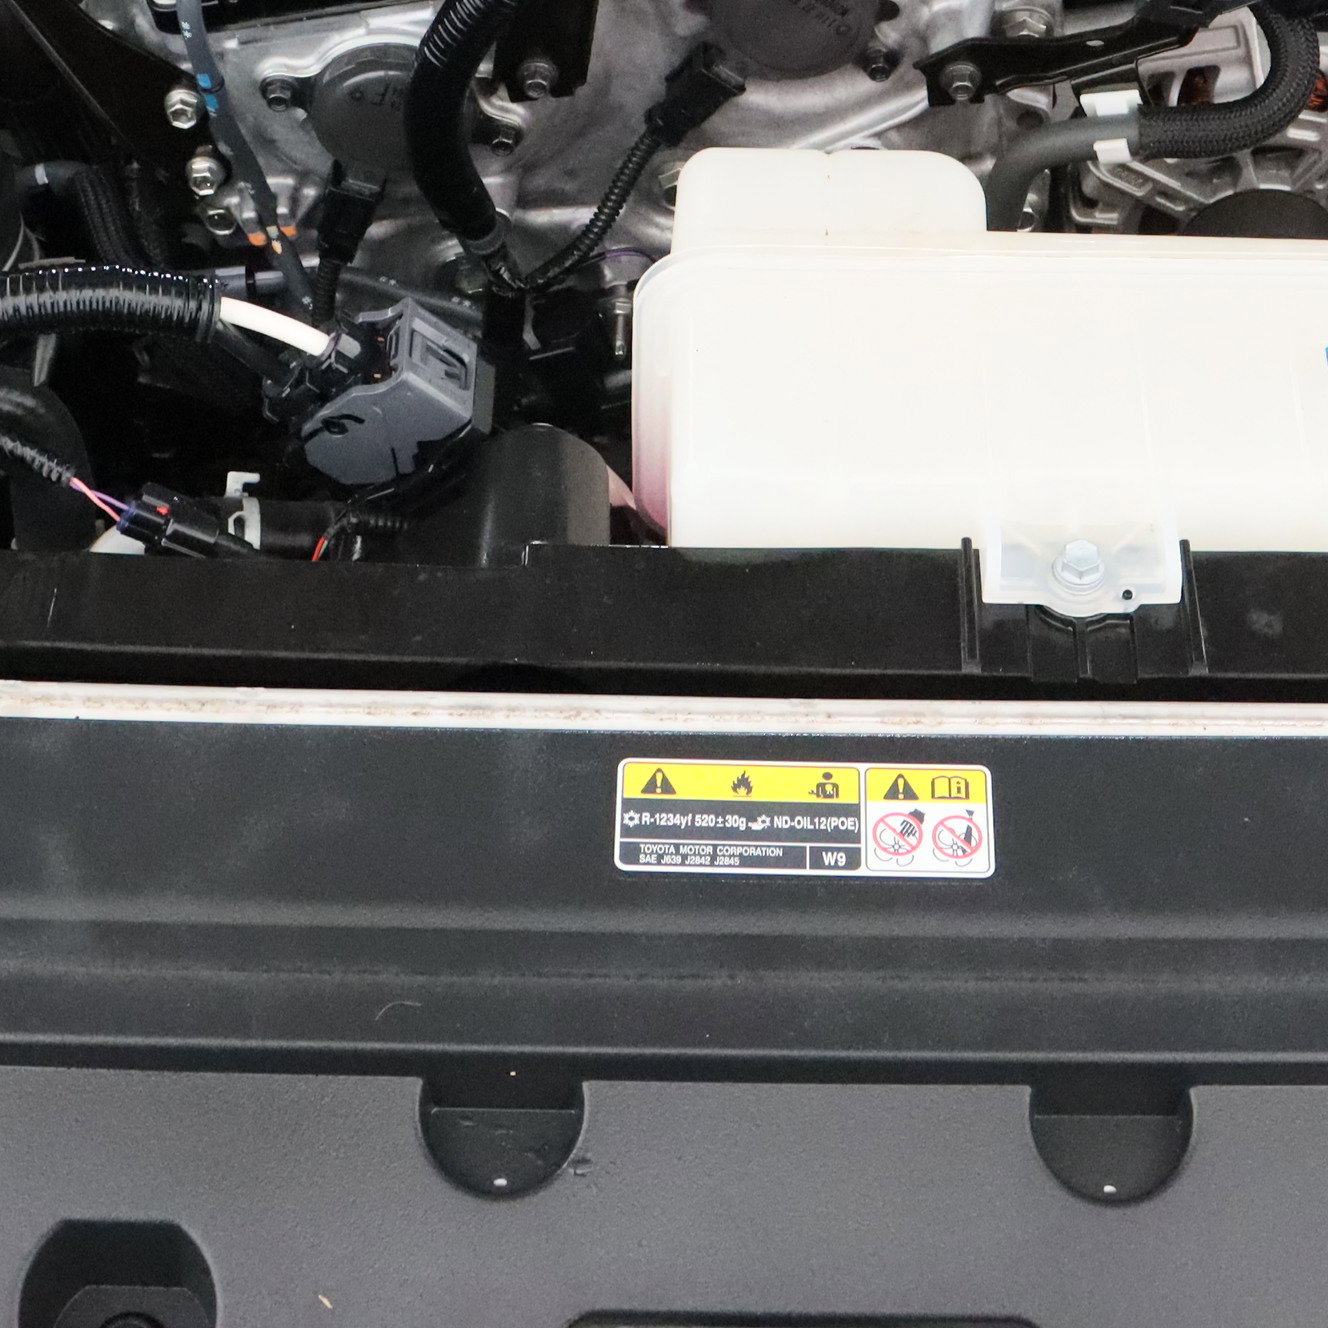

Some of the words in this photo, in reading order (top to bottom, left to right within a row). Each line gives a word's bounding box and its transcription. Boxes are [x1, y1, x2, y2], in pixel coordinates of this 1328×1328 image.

[641, 812, 692, 829] R-1234yf
[694, 813, 747, 831] 520±30g
[773, 813, 859, 833] ND-OIL12(POE)
[639, 844, 676, 855] TOYOTA
[679, 845, 713, 856] MOTOR
[716, 846, 783, 857] CORPORATION
[639, 854, 657, 864] SAE
[661, 855, 682, 865] J639
[685, 856, 711, 865] J2842
[714, 856, 740, 866] J2845
[822, 851, 847, 866] W9
